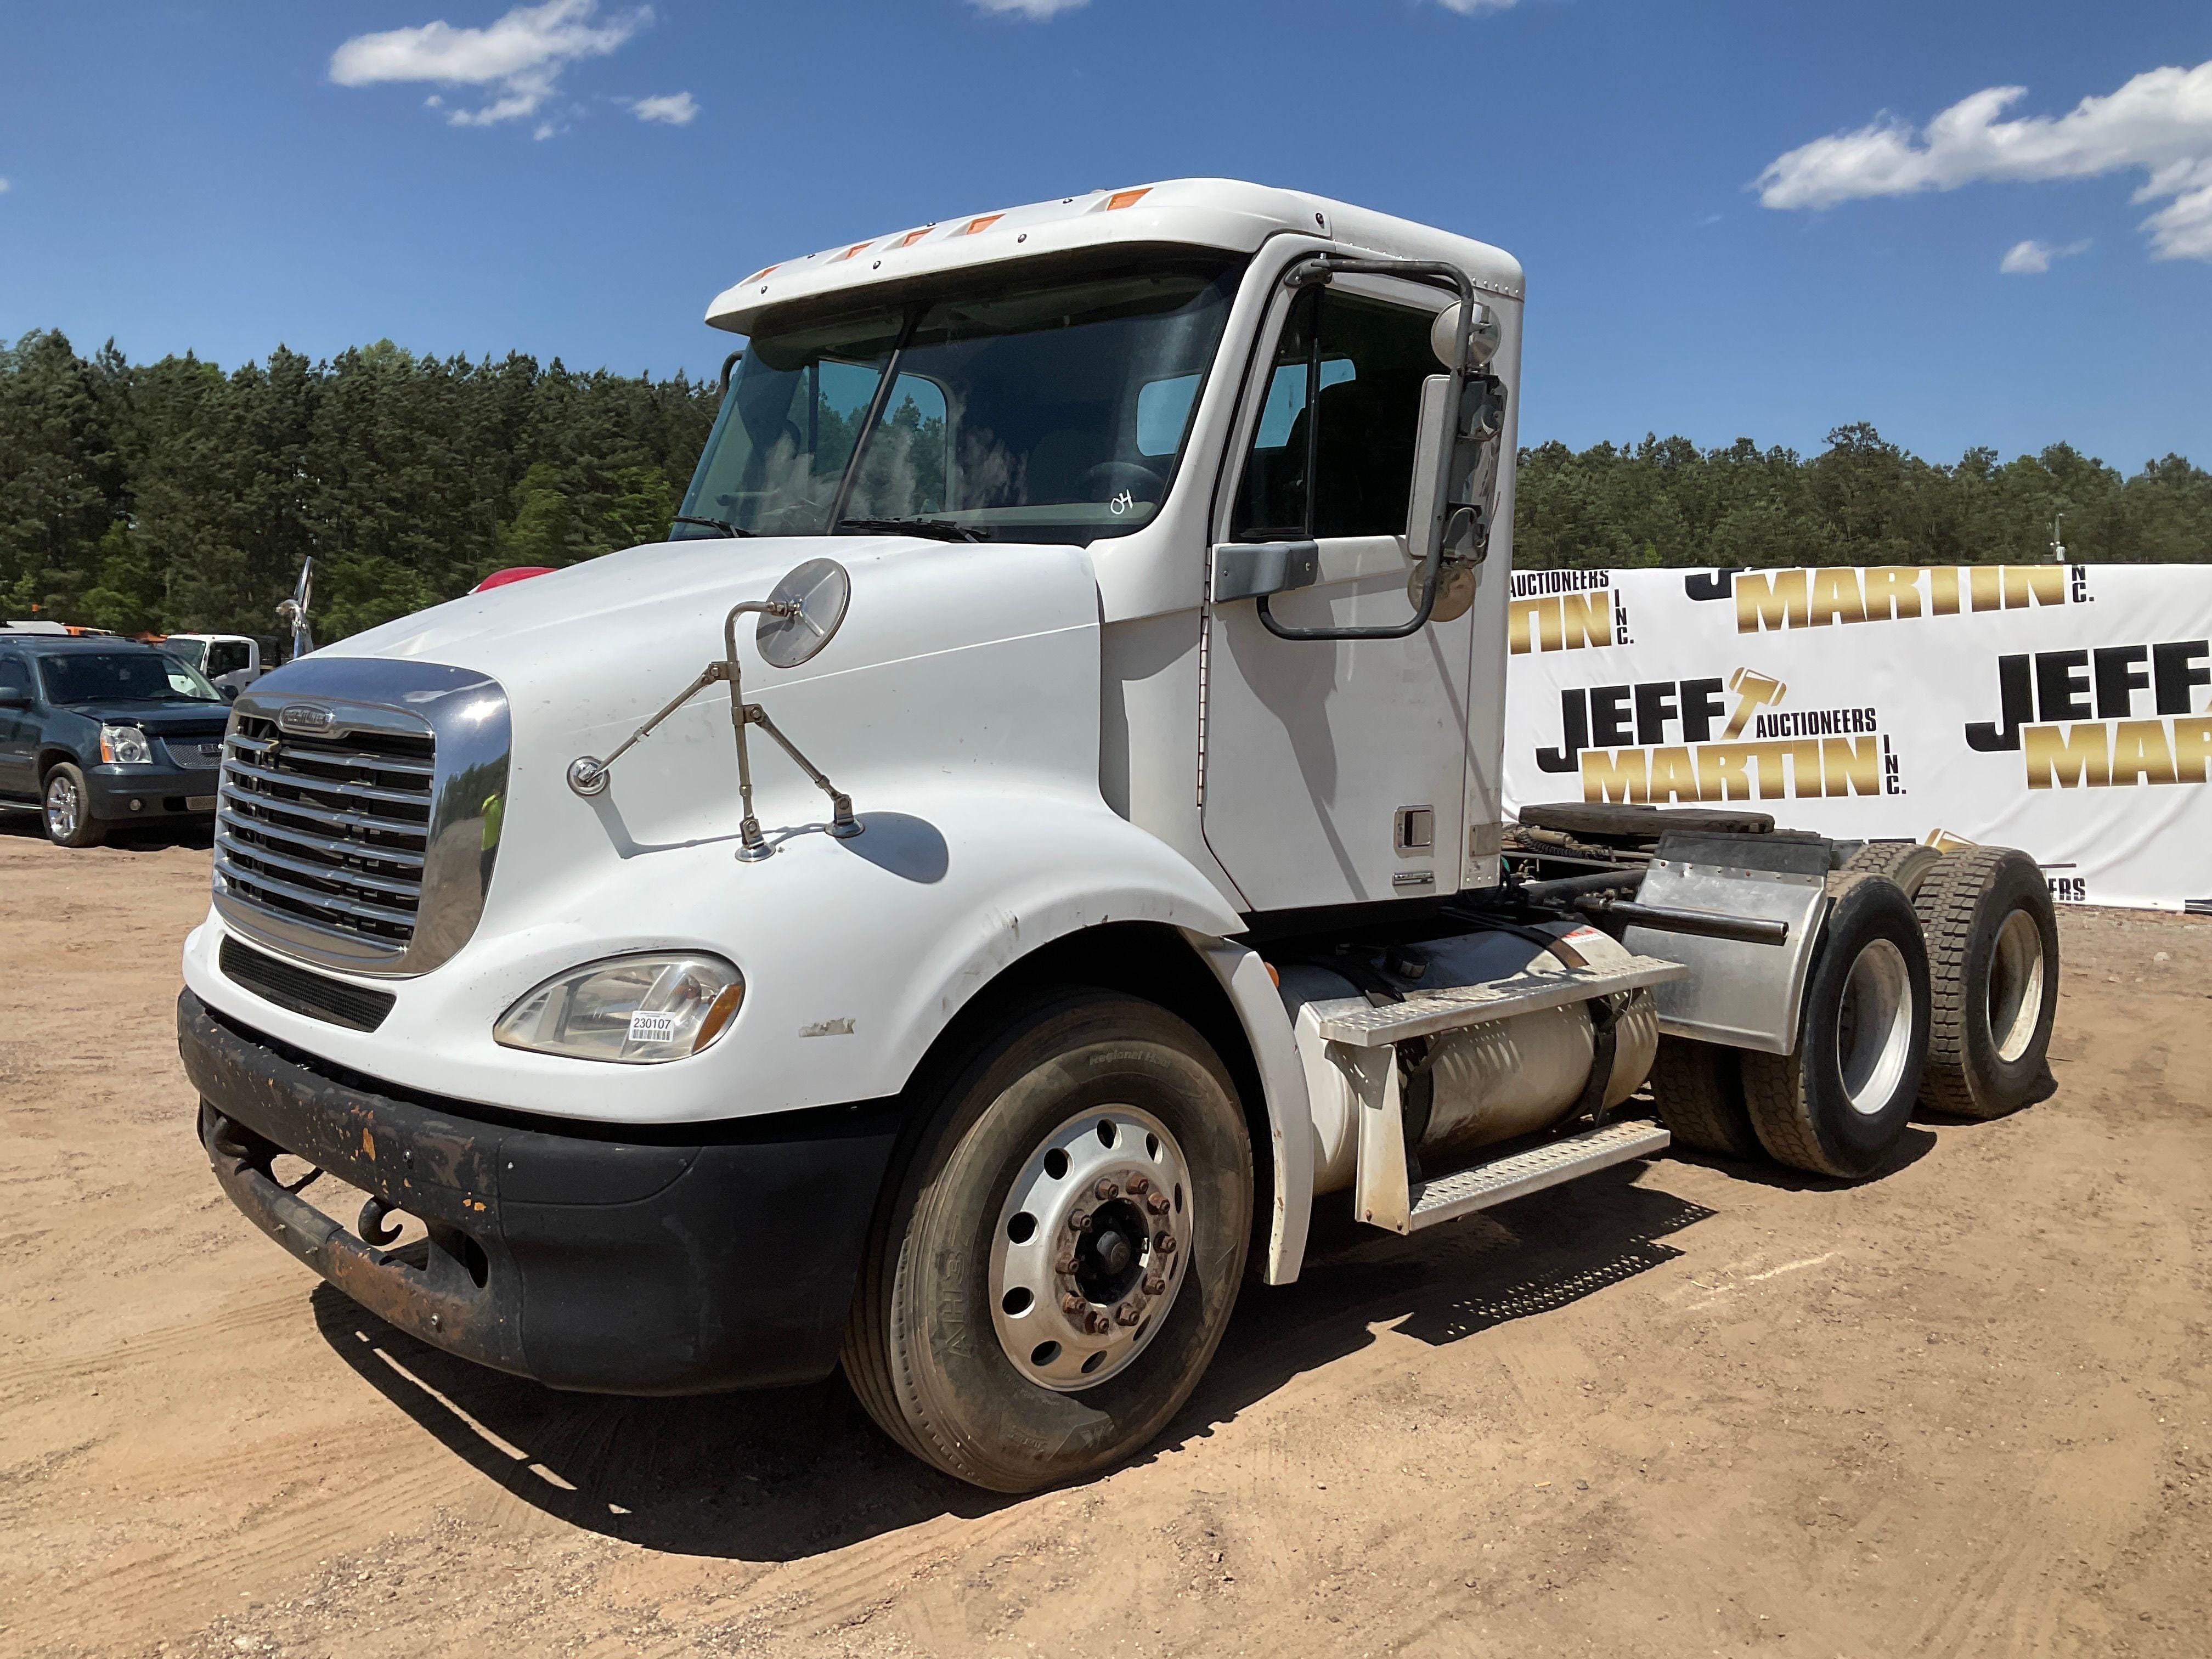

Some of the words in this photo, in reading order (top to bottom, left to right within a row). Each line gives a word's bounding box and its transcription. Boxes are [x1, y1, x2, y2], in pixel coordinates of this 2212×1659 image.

[2071, 566, 2095, 602] NC.
[1509, 590, 1612, 655] TIN
[1614, 589, 1634, 645] INC.
[1535, 678, 1725, 774] JEFF
[1756, 708, 1877, 738] AUCTIONEERS
[1965, 640, 2211, 752] JEFF
[1581, 736, 1880, 804] MARTIN
[1883, 734, 1906, 795] INC.
[2024, 717, 2212, 789] MAR
[633, 1018, 672, 1029] 230107
